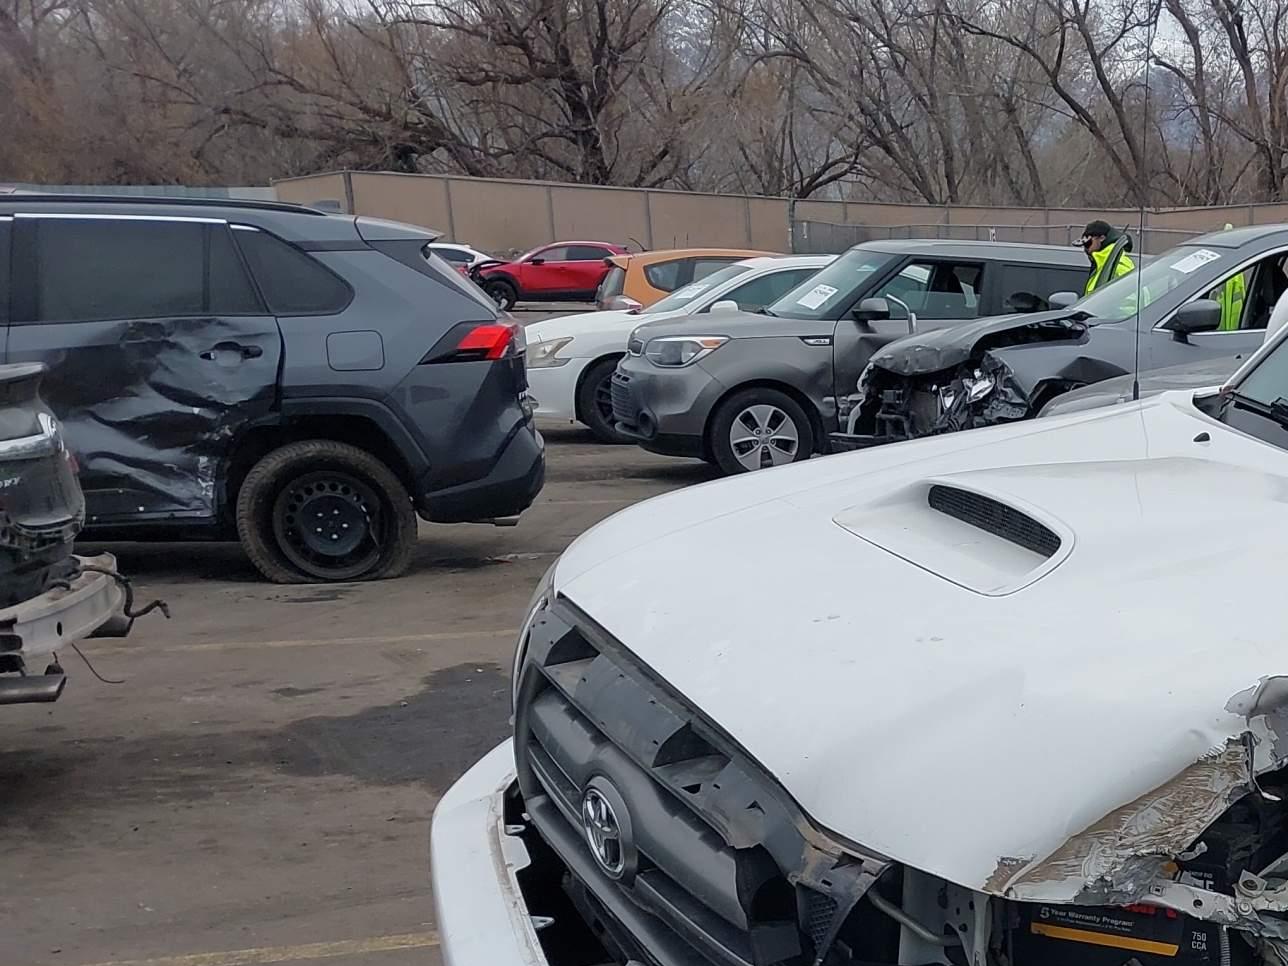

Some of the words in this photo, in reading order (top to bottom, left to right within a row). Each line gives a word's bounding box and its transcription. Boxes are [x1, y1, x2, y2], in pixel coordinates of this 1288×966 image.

[1039, 906, 1051, 919] 5
[1051, 908, 1067, 918] Year
[1067, 911, 1101, 924] Warranty
[1102, 916, 1134, 927] Program
[1191, 931, 1207, 942] 750
[1191, 941, 1207, 951] CCA
